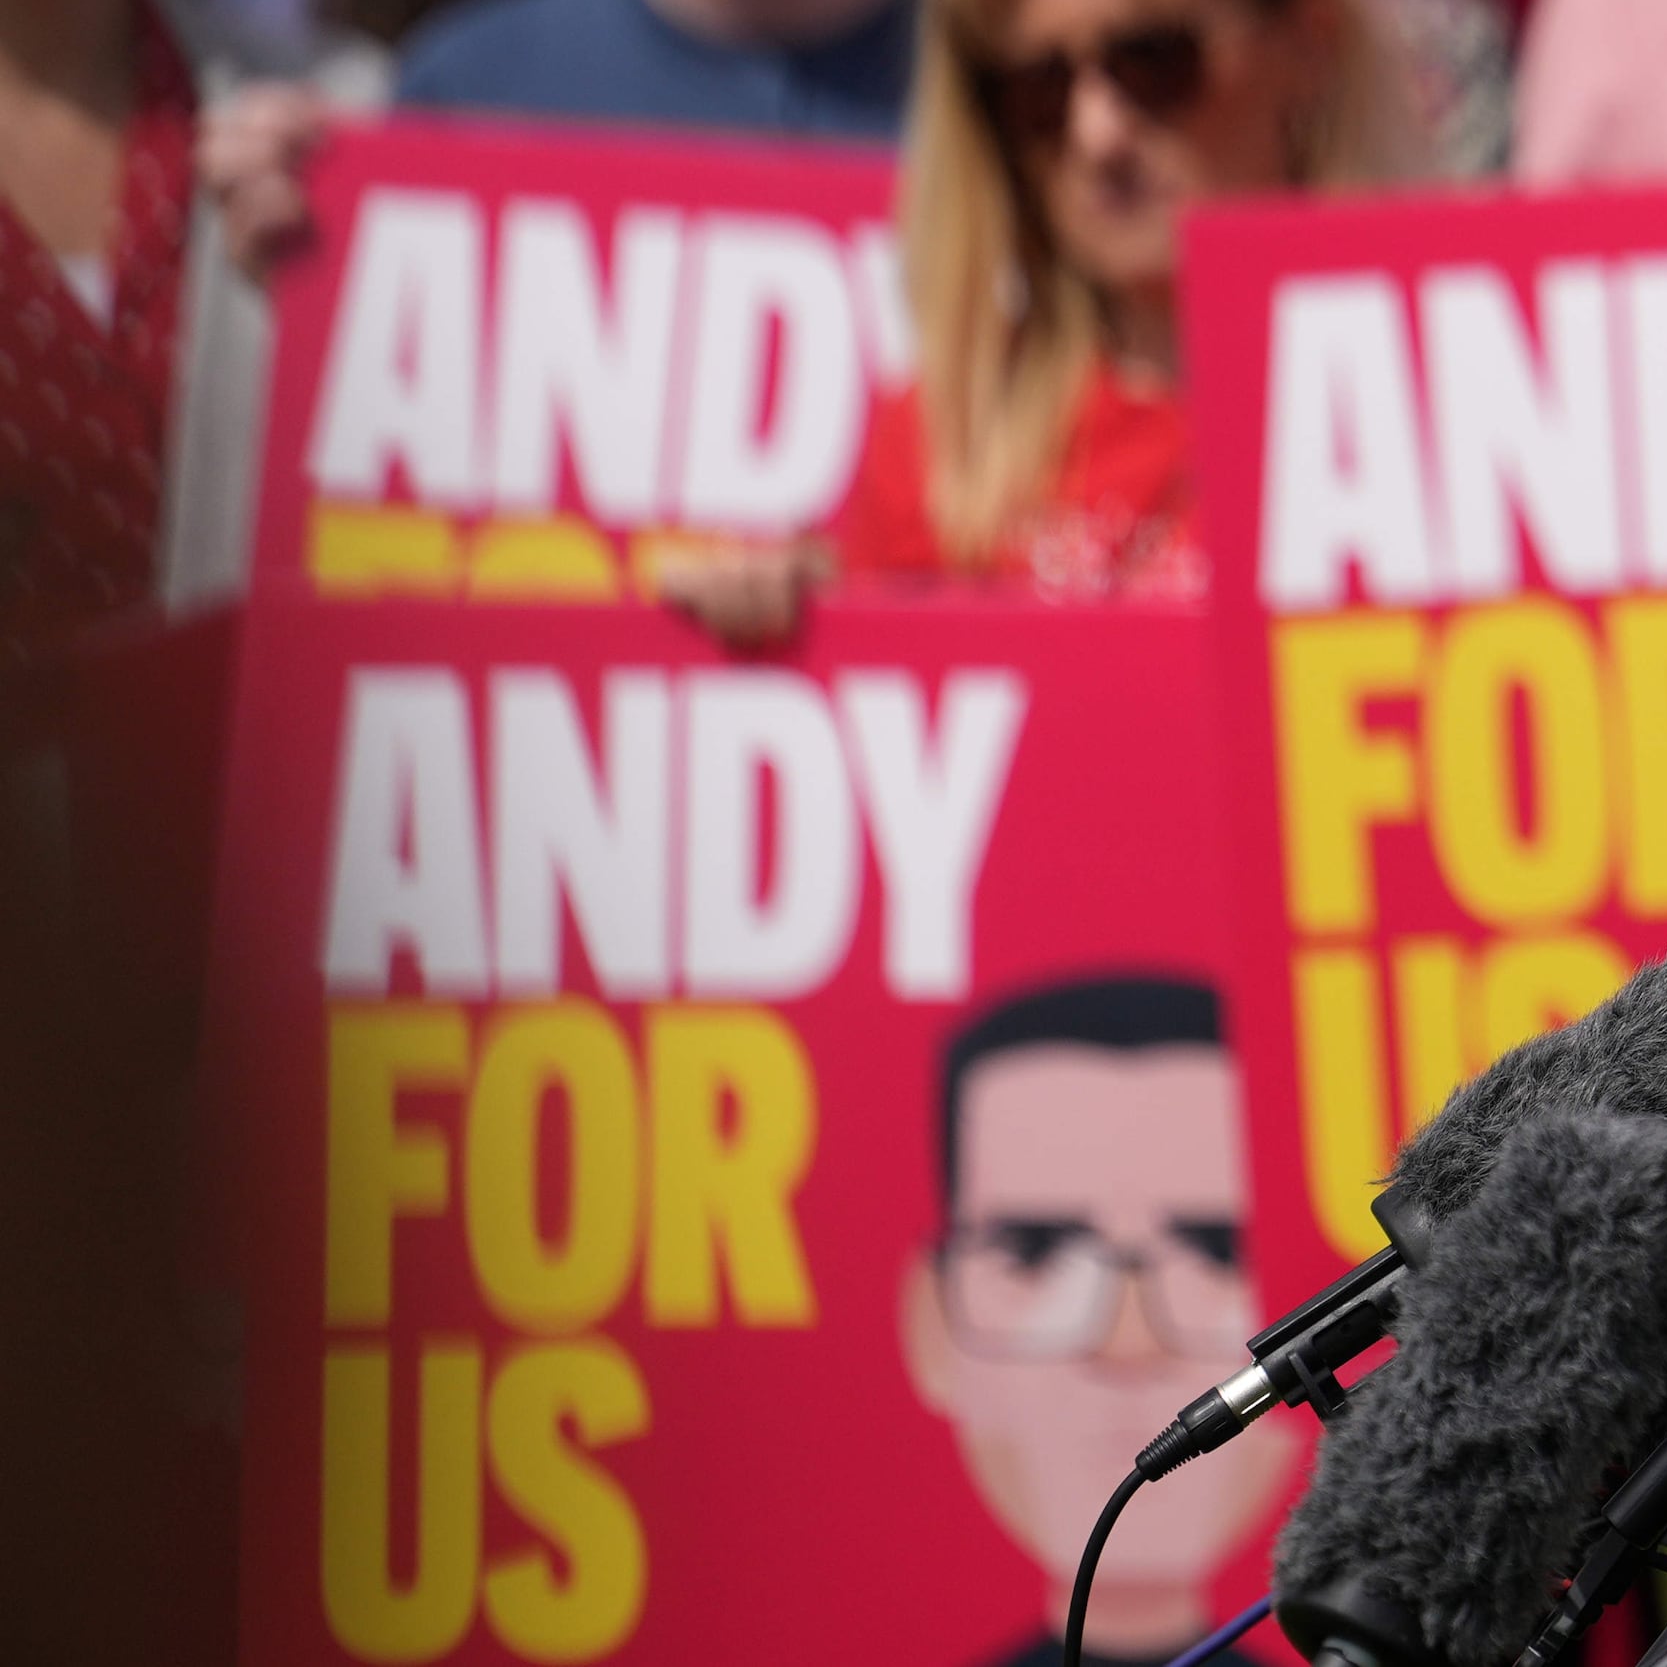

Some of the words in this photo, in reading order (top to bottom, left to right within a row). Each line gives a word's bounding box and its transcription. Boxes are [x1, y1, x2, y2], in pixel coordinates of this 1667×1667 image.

[321, 665, 1027, 1002] ANDY
[323, 994, 818, 1331] FOR
[321, 1334, 652, 1665] US
